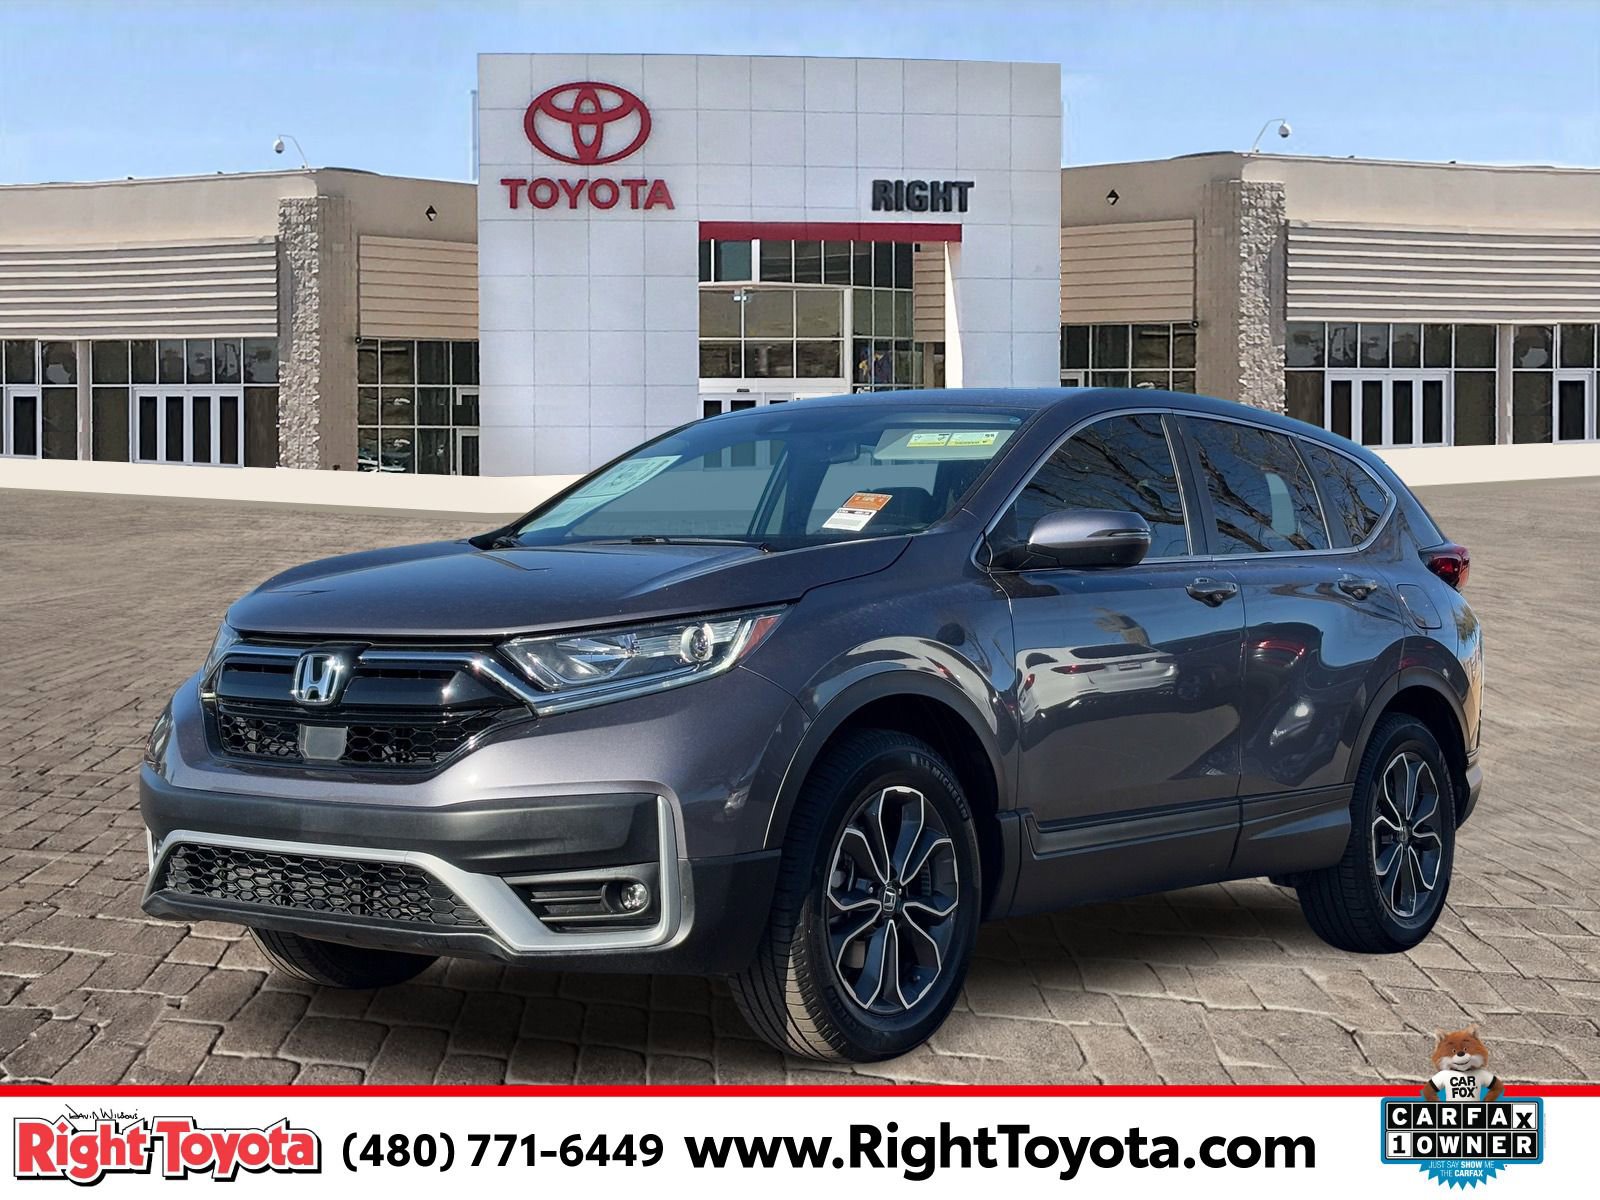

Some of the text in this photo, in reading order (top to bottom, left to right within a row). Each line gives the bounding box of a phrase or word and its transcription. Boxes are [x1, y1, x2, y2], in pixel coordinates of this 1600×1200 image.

[500, 178, 675, 210] TOYOTA
[871, 179, 975, 213] RIGHT
[931, 765, 968, 819] MICHELIN
